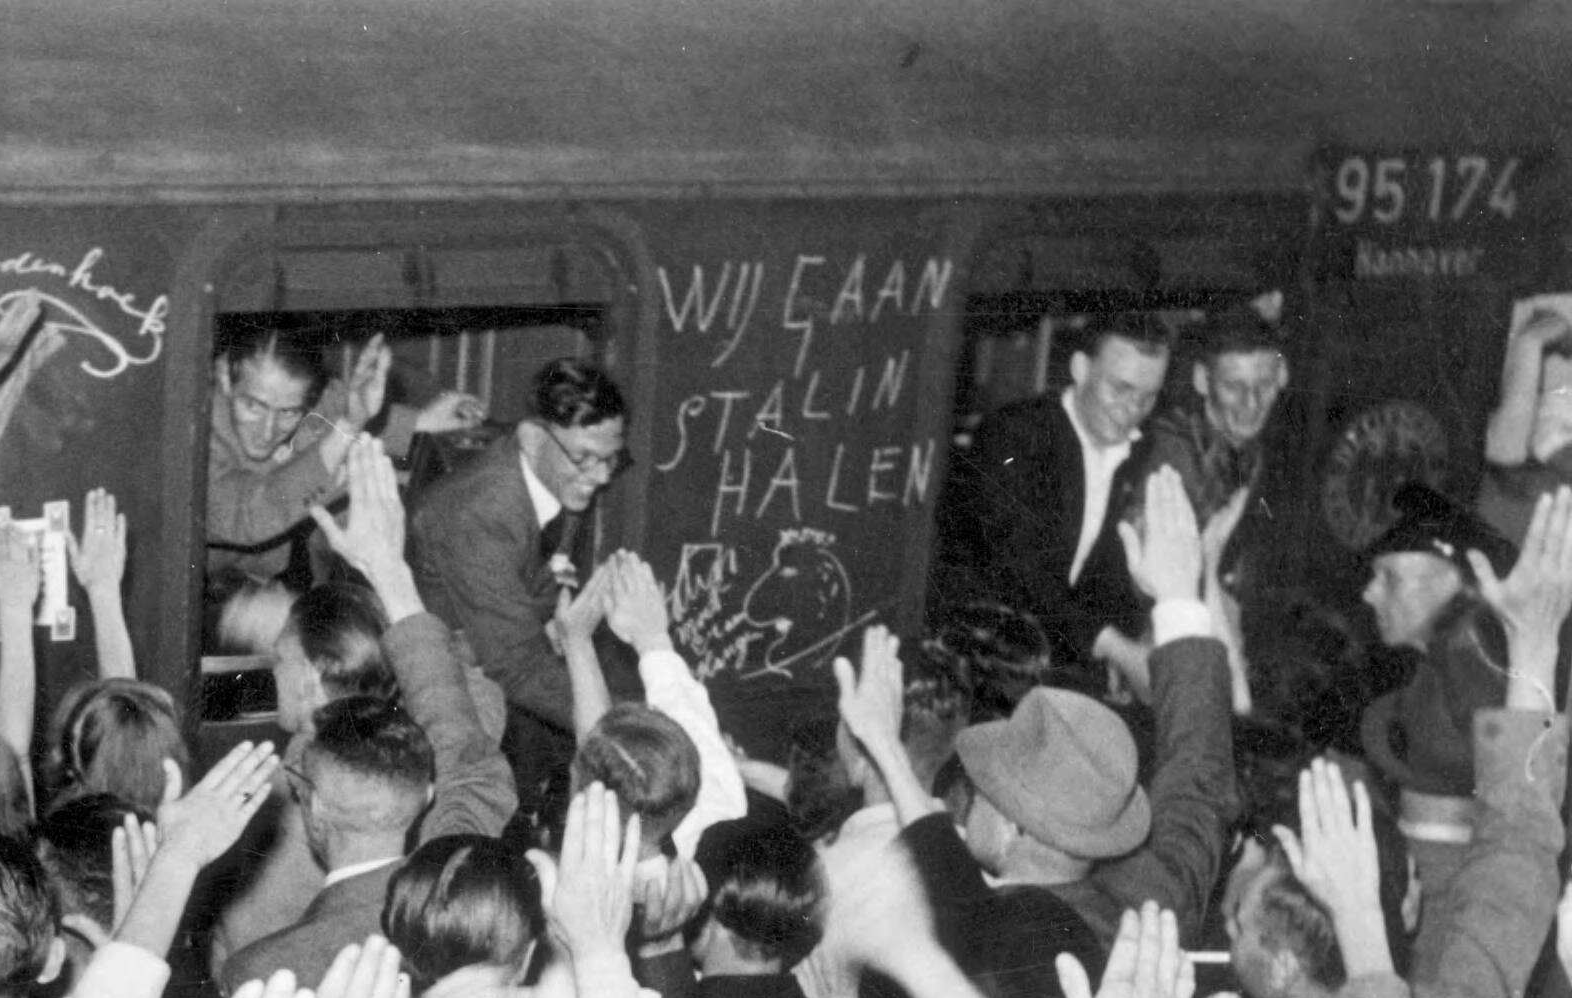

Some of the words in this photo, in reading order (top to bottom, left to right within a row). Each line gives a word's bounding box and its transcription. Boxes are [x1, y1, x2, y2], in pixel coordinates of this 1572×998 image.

[1335, 156, 1406, 224] 95
[1428, 156, 1520, 222] 174
[657, 260, 764, 369] WIJ
[783, 253, 954, 380] GAAN
[656, 348, 911, 471] STALIN
[711, 437, 936, 538] HALEN
